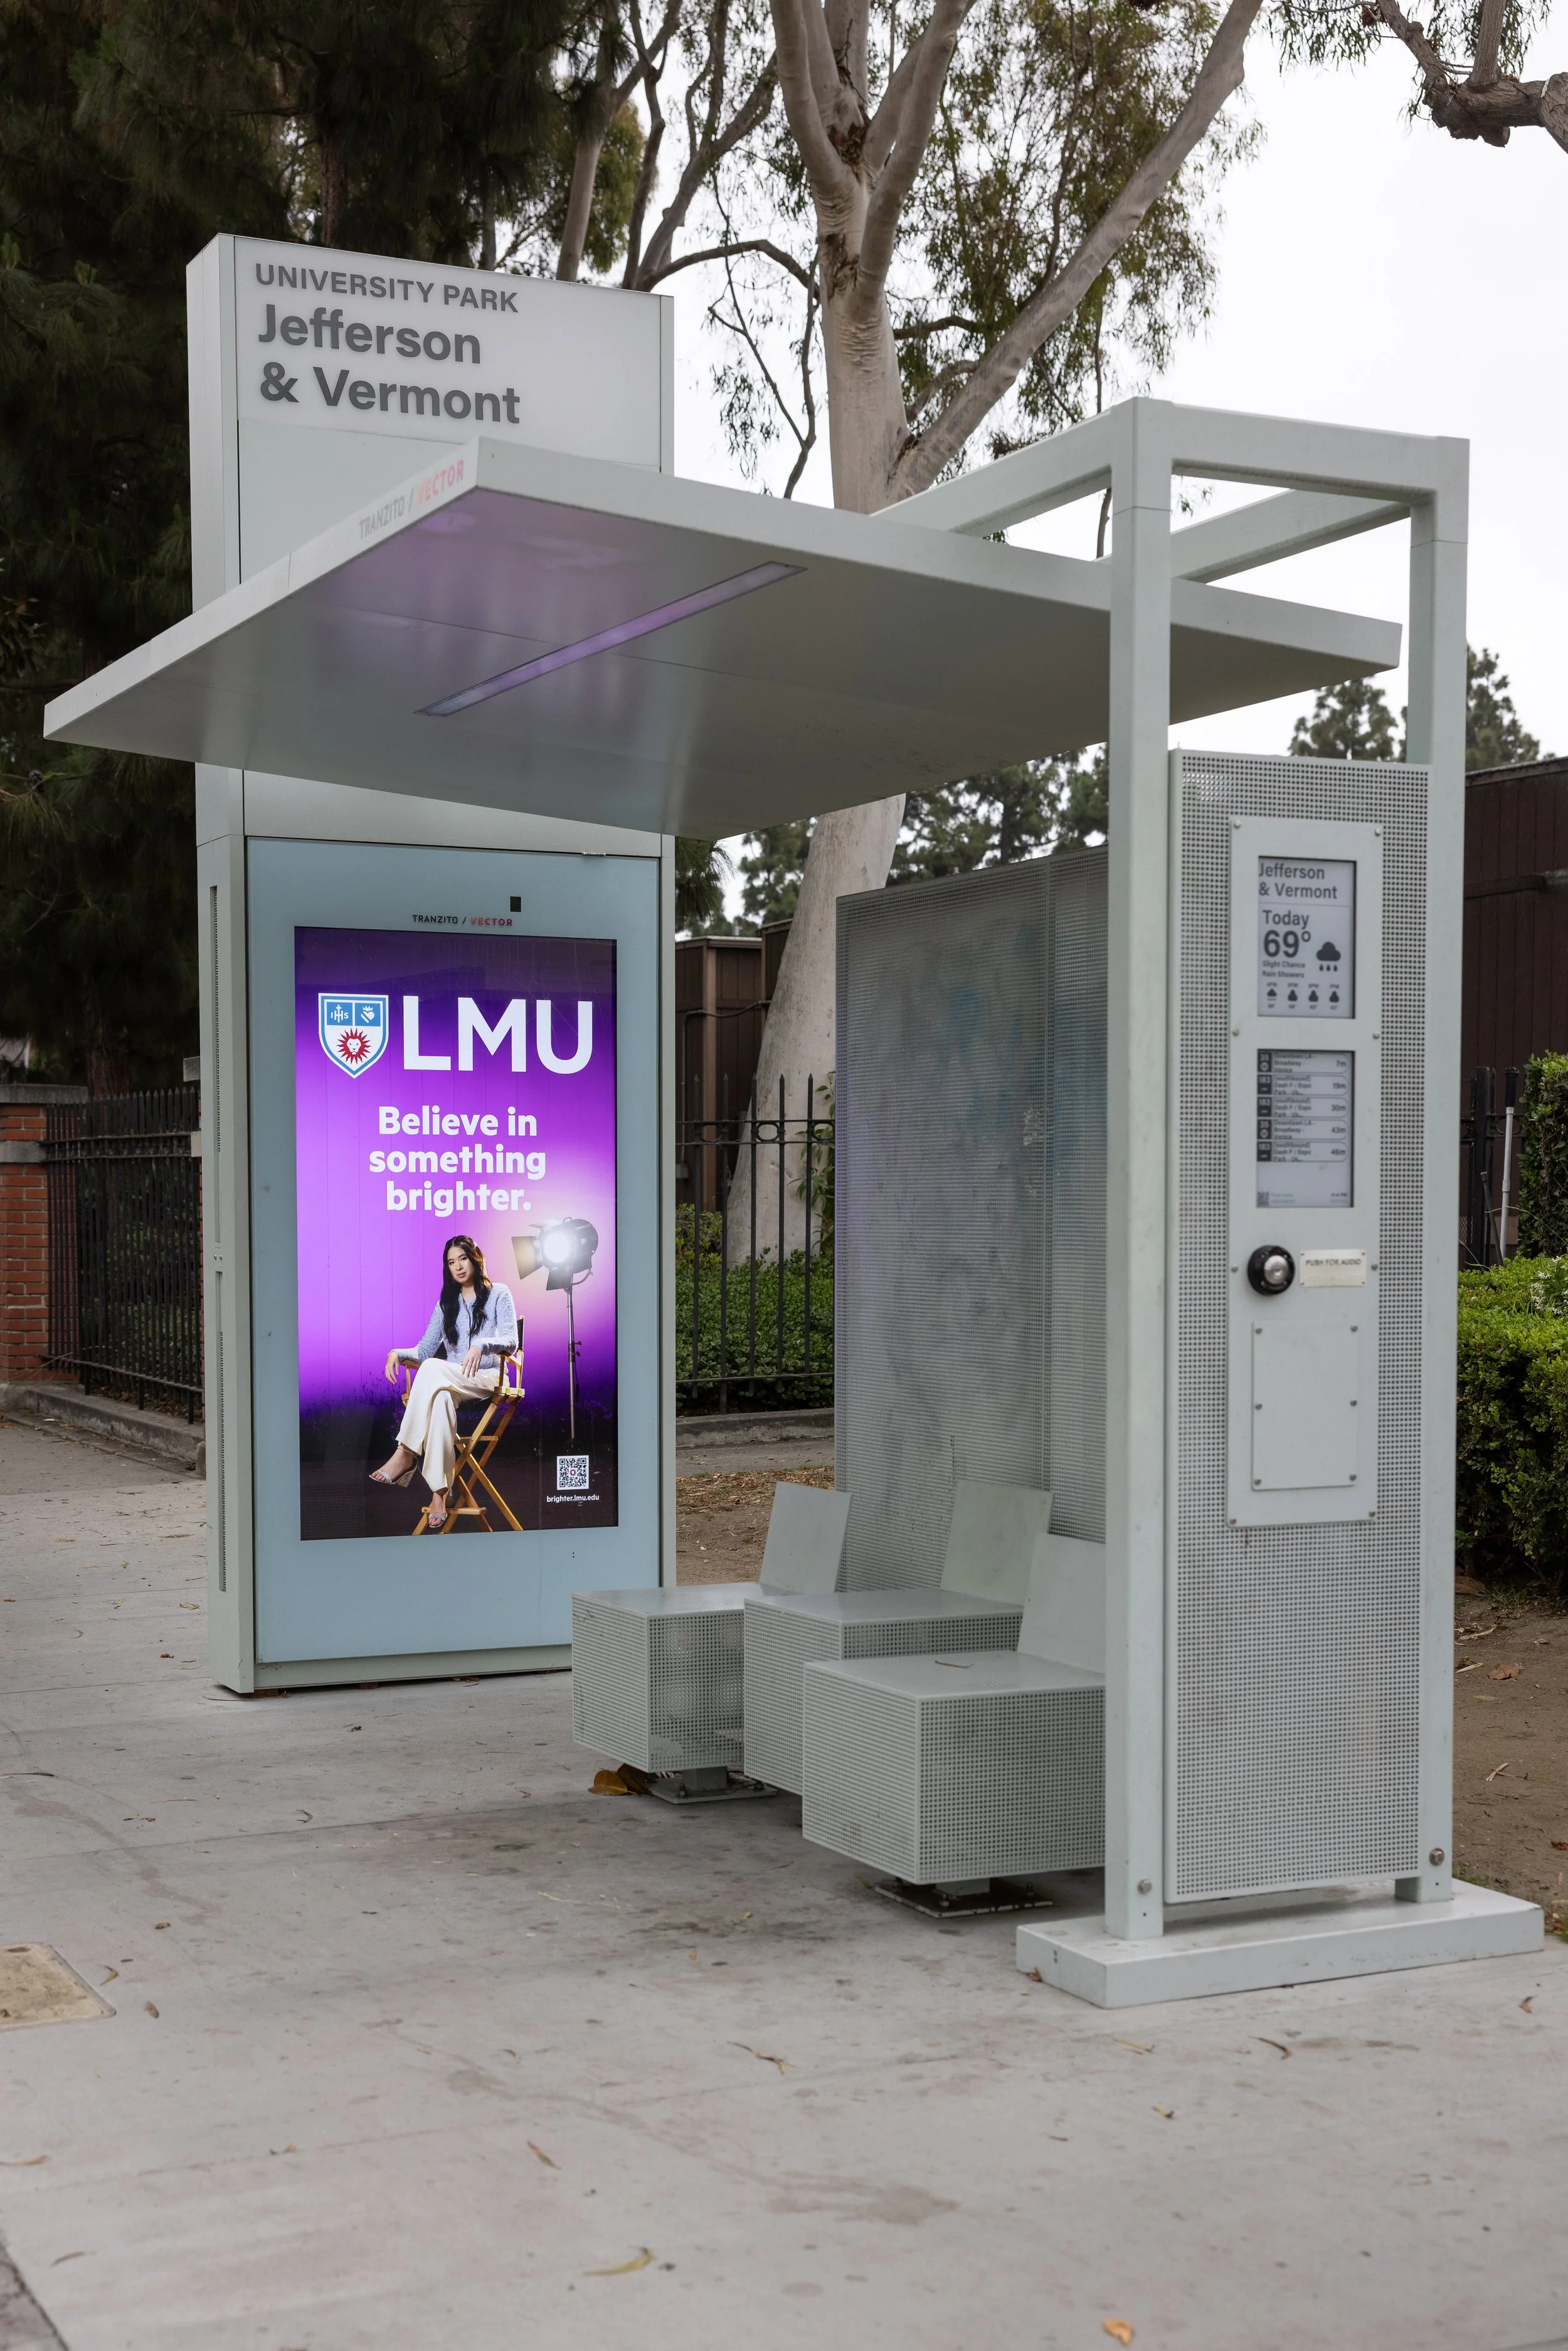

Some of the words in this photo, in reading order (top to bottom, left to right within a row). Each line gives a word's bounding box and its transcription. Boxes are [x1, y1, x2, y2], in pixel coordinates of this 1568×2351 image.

[256, 263, 434, 303] UNIVERSITY
[443, 285, 519, 313] PARK
[258, 304, 481, 364] Jefferson
[260, 361, 300, 403] &
[313, 366, 521, 424] Vermont
[359, 496, 405, 539] TRANZITO
[417, 459, 464, 505] VECTOR
[1259, 862, 1325, 879] Jefferson
[1259, 882, 1269, 896] &
[1274, 883, 1337, 899] Vermont
[412, 915, 458, 925] TRANZITO
[470, 917, 513, 926] VECTOR
[1262, 910, 1310, 930] Today
[403, 995, 593, 1074] LMU
[379, 1105, 499, 1136] Believe
[507, 1107, 538, 1136] in
[369, 1144, 546, 1180] something
[386, 1181, 532, 1217] brighter.
[546, 1494, 600, 1503] brighter.lmu.edu
